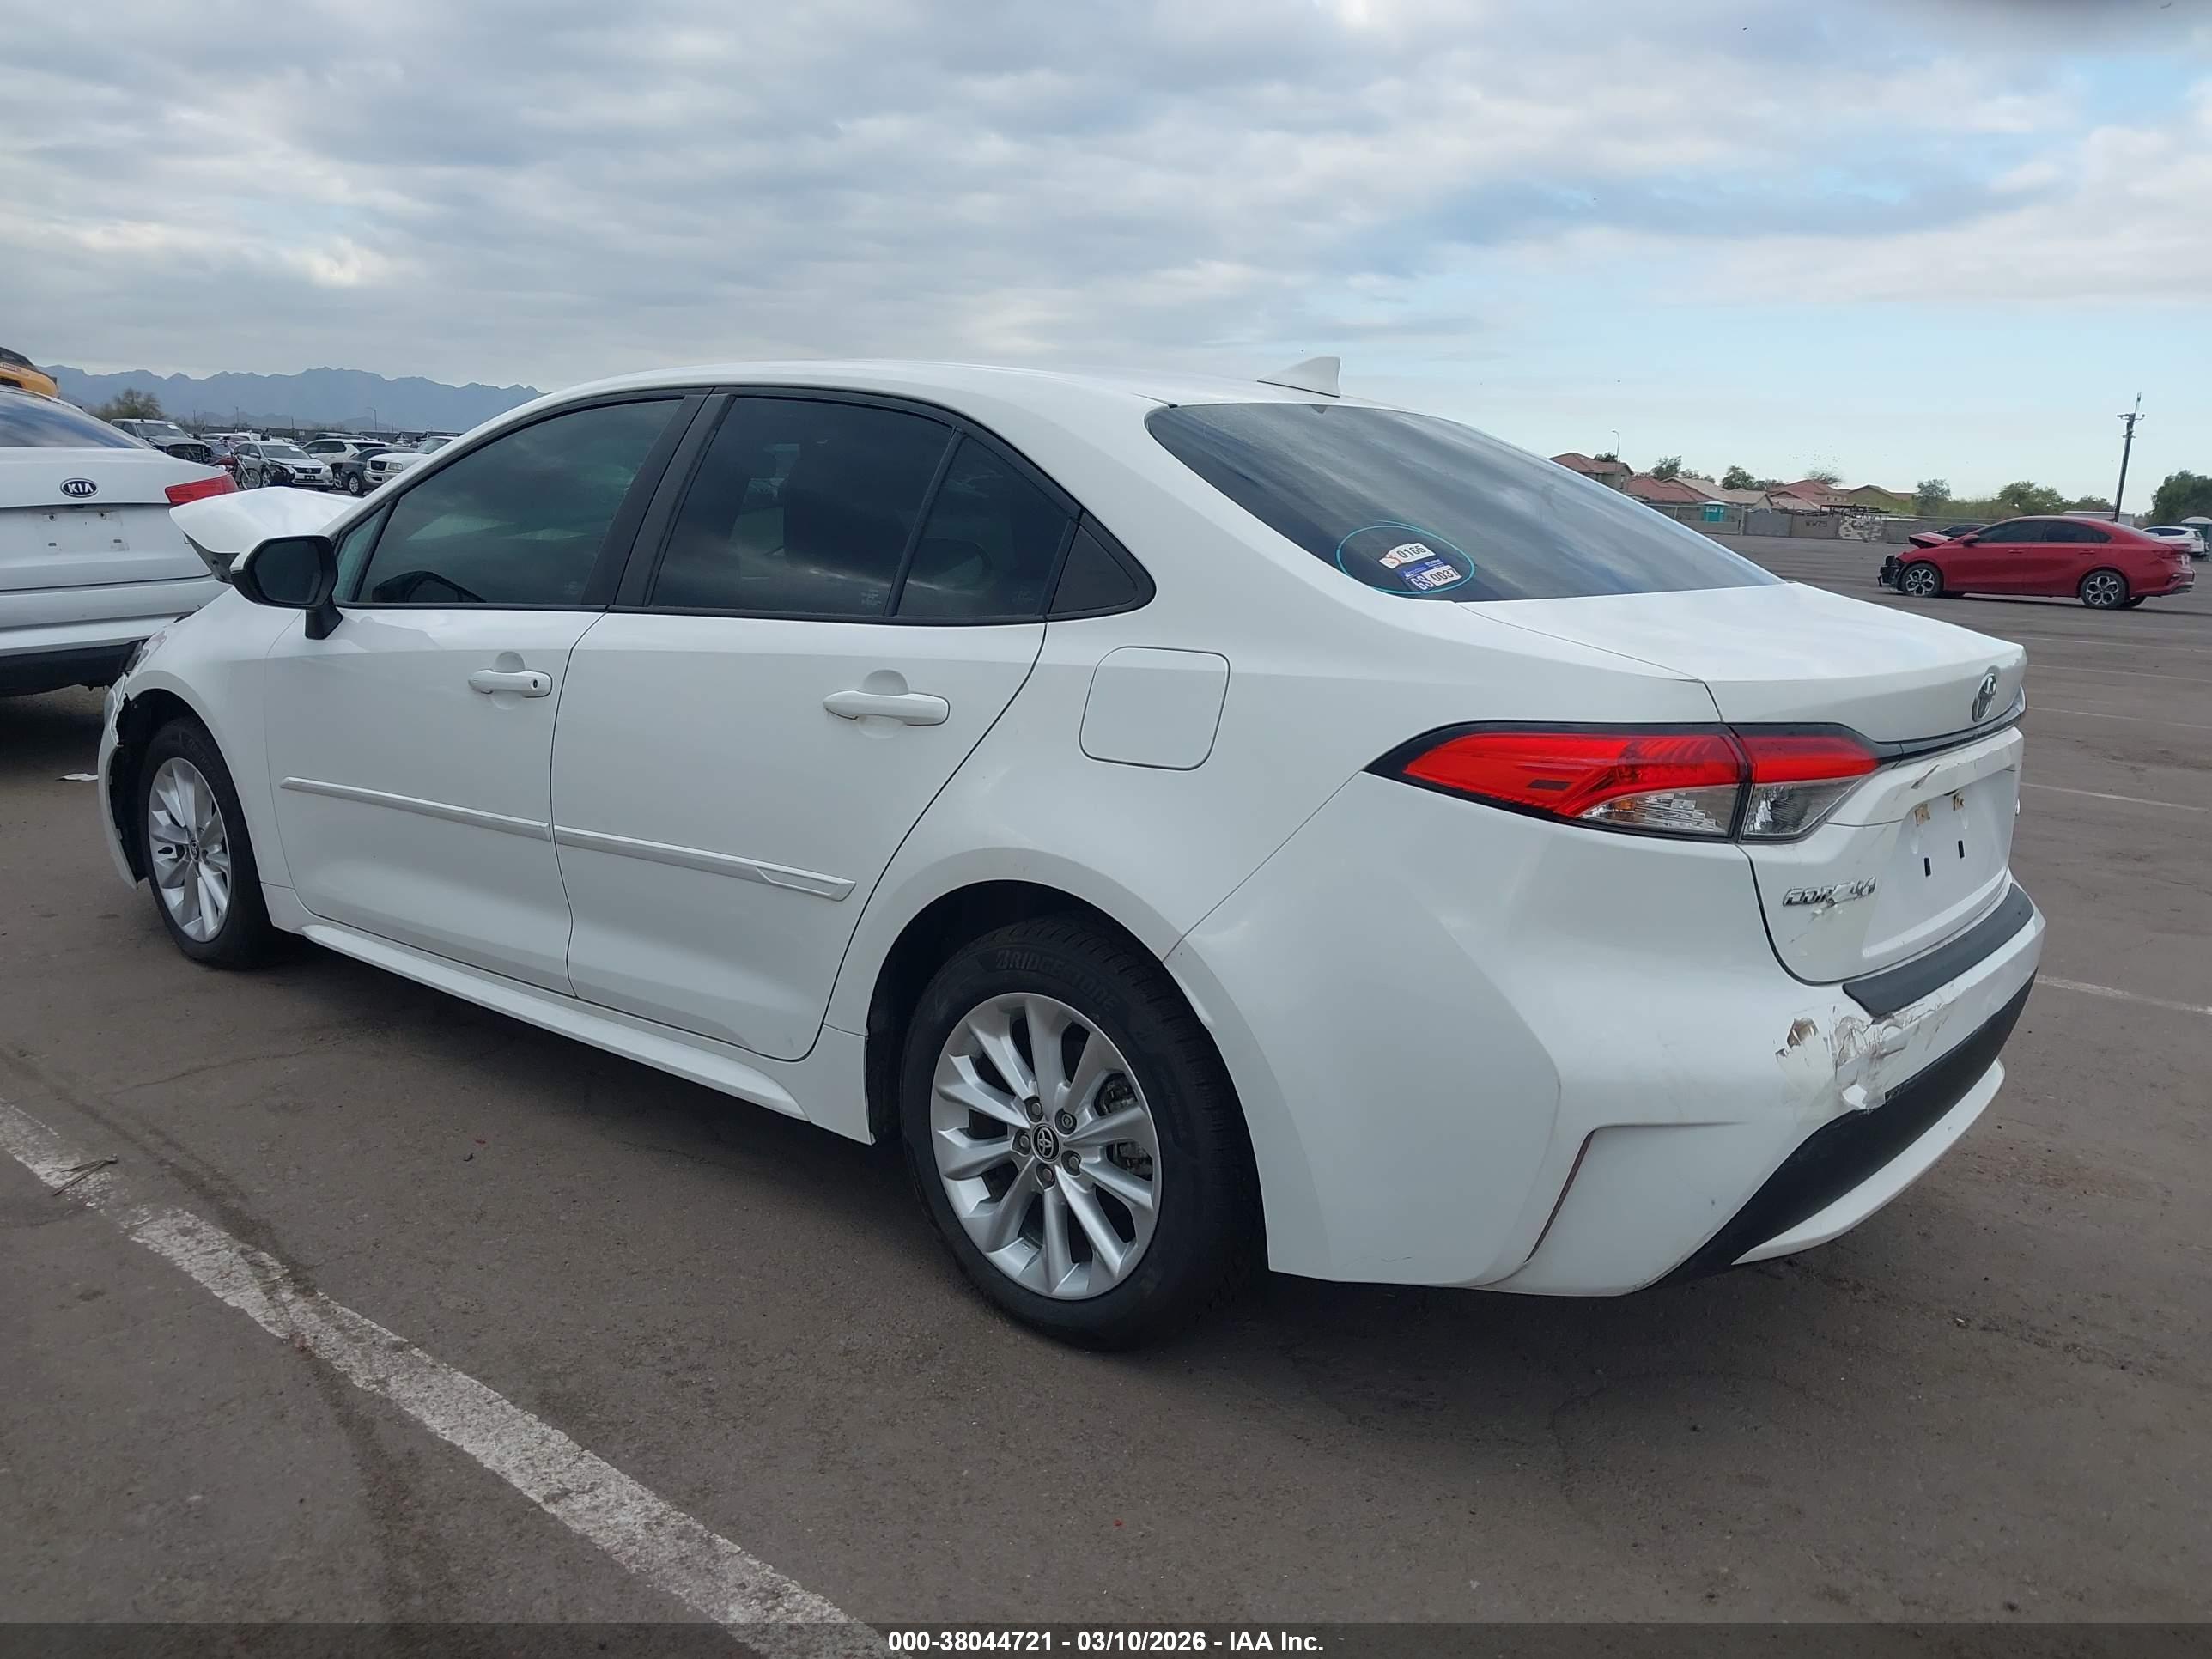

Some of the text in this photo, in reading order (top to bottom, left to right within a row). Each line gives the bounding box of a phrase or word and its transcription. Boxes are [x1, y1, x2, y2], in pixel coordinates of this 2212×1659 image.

[67, 483, 94, 494] KIA
[1397, 546, 1425, 558] 0165
[1430, 568, 1458, 581] 0037
